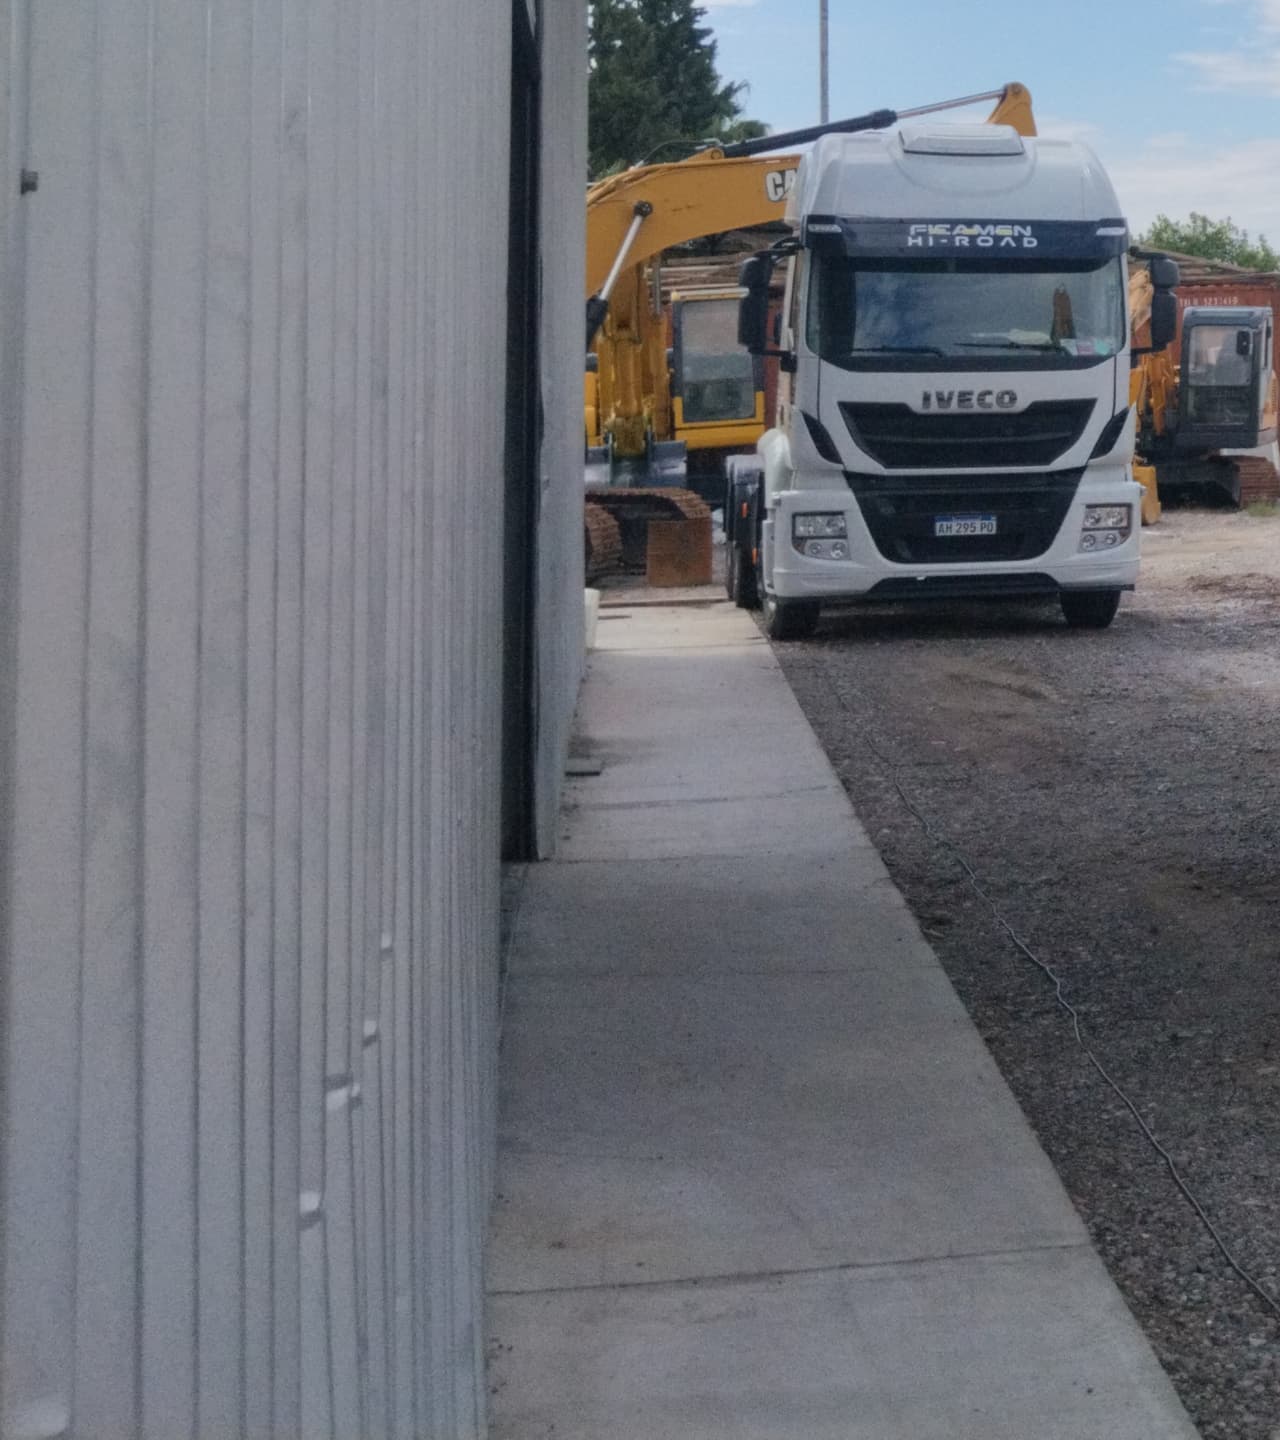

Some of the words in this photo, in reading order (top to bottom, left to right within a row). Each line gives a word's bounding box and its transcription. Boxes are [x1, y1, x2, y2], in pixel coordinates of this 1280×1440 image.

[765, 167, 798, 202] CA
[907, 236, 1038, 248] HI-ROAD
[922, 389, 1018, 409] IVECO
[938, 523, 953, 534] AH
[956, 522, 977, 534] 295
